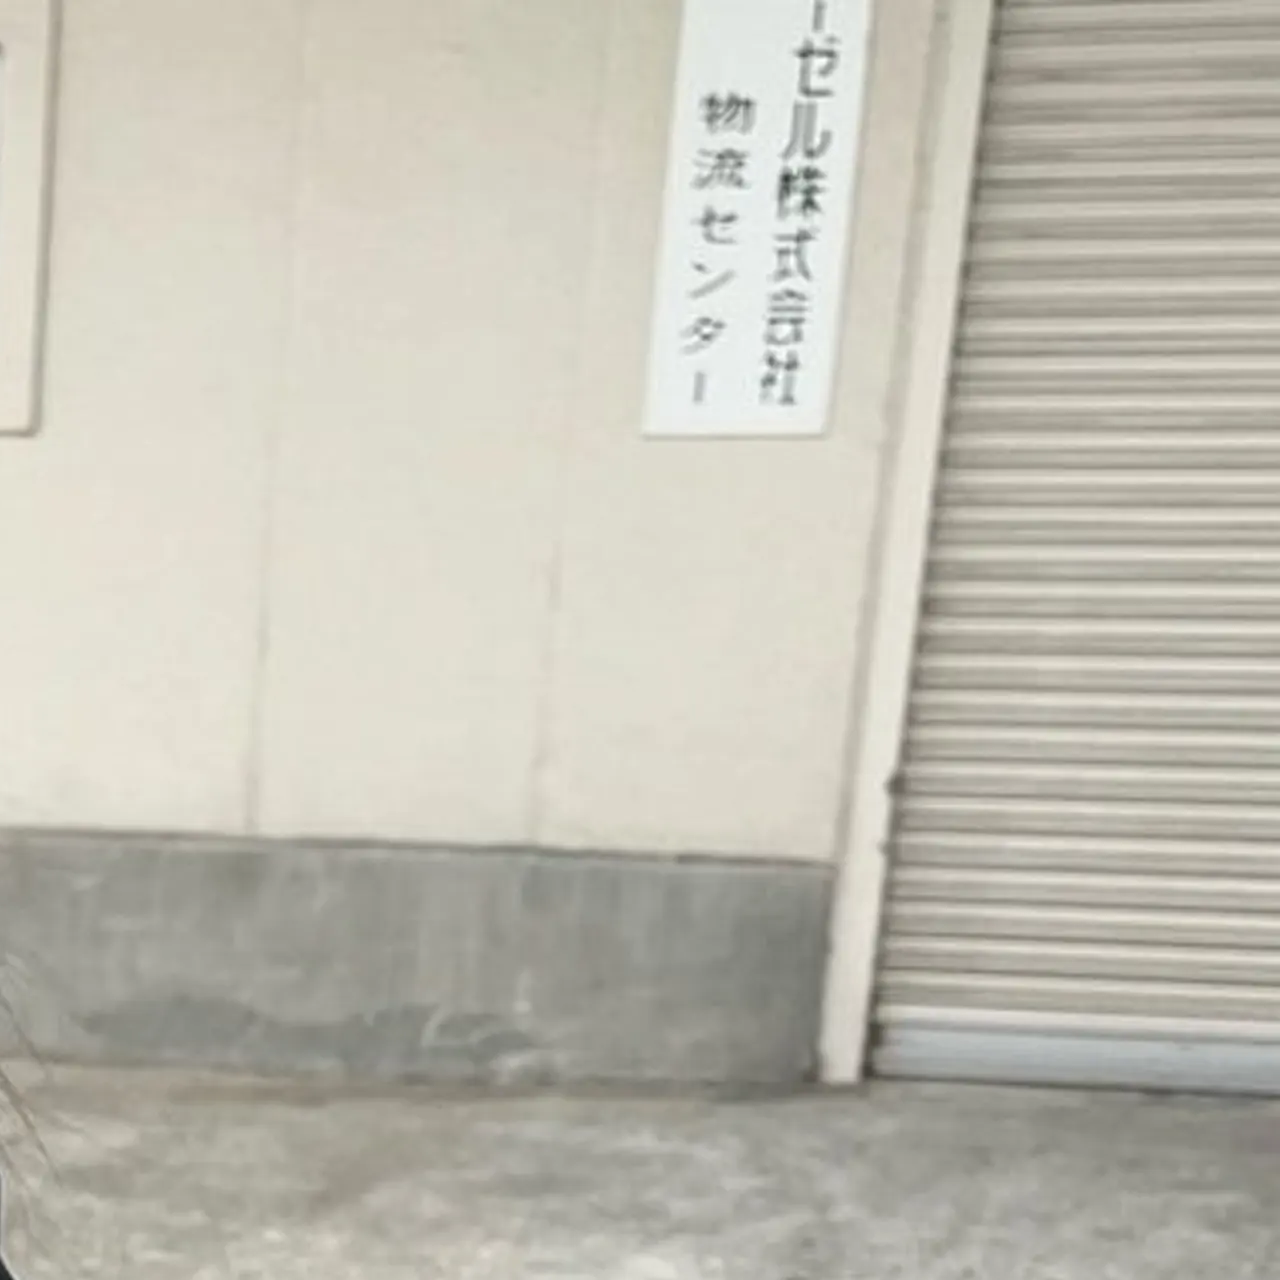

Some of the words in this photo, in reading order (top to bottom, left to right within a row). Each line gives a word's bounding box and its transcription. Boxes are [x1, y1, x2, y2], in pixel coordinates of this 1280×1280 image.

[679, 91, 756, 405] 物流センター
